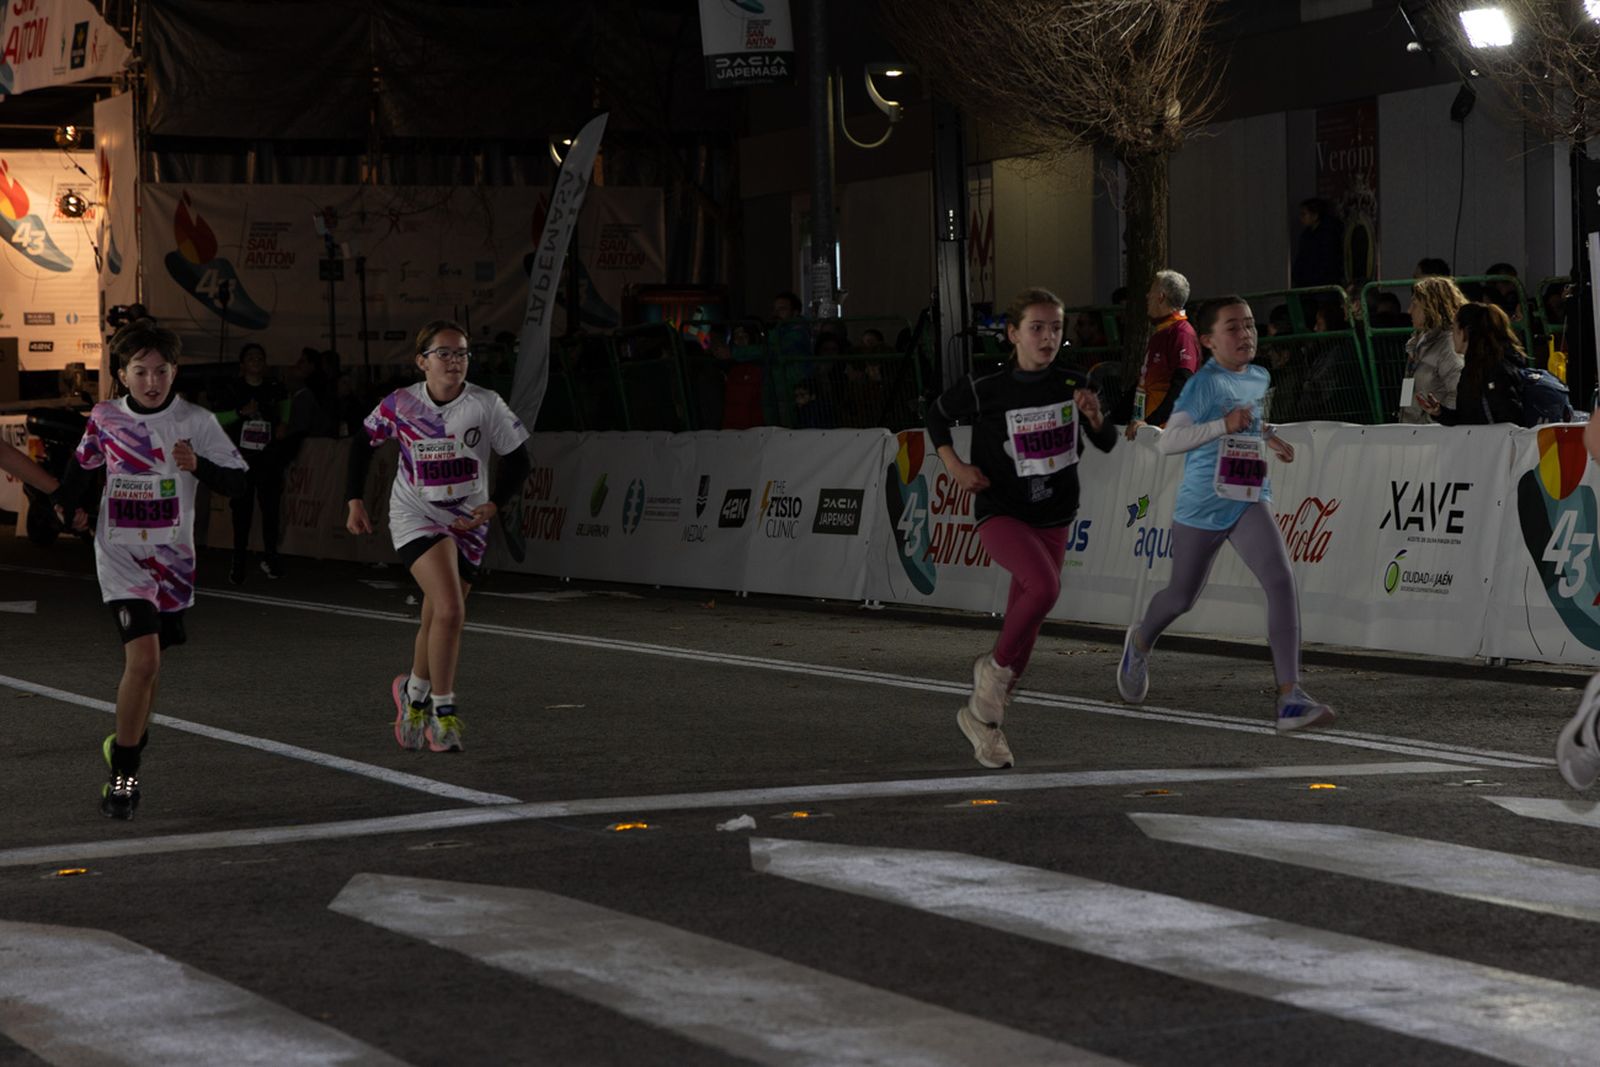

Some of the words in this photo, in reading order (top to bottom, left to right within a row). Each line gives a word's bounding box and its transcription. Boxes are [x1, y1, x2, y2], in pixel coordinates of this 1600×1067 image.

[714, 56, 786, 68] DACIA
[716, 66, 788, 79] JAPEMASA
[11, 222, 46, 255] 43
[822, 497, 858, 509] DACIA
[931, 473, 972, 516] SAN
[115, 499, 173, 521] 14639
[721, 497, 749, 520] 42K
[767, 496, 802, 518] FISIO
[1379, 480, 1469, 534] XAVE
[766, 518, 800, 540] CLINIC
[897, 492, 927, 557] 43
[1541, 510, 1596, 599] 43
[1402, 570, 1430, 584] CIUDAD
[1433, 570, 1454, 587] JAÉN
